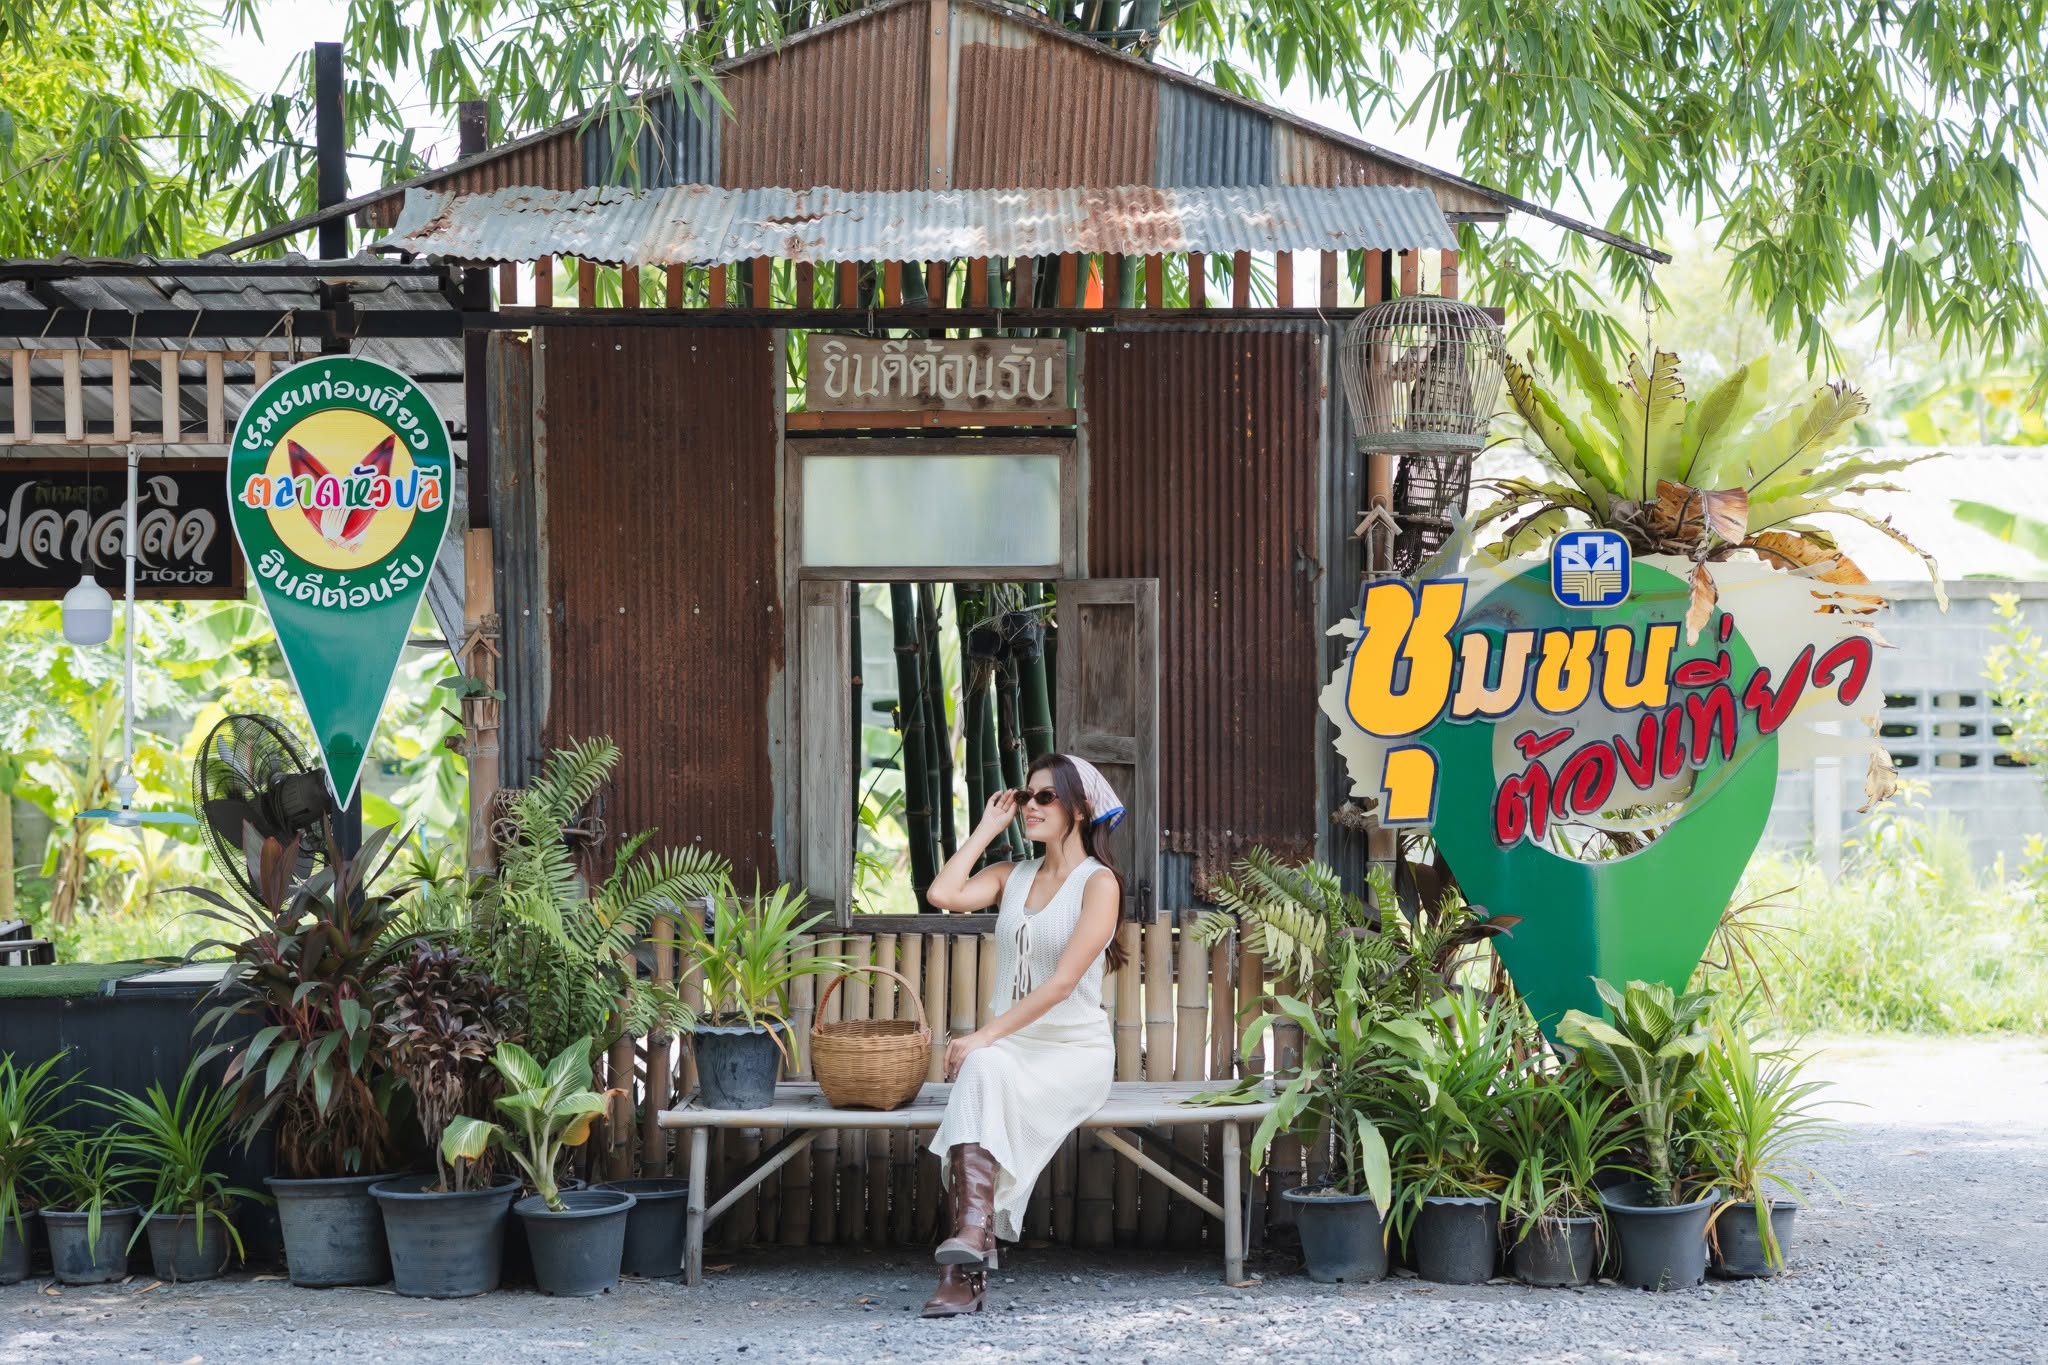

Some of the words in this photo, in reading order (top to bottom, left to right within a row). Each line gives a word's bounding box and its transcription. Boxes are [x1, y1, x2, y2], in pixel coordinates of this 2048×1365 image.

[823, 339, 1053, 401] ยินดีต้อนรับ
[242, 369, 430, 450] ชุมชนท่องเที่ยว
[239, 465, 443, 512] ตลาดหัวปลี
[257, 549, 425, 610] ยินดีต้อนรับ
[1345, 577, 1682, 825] ชุมชน
[1494, 612, 1874, 846] ต้องเที่ยว
